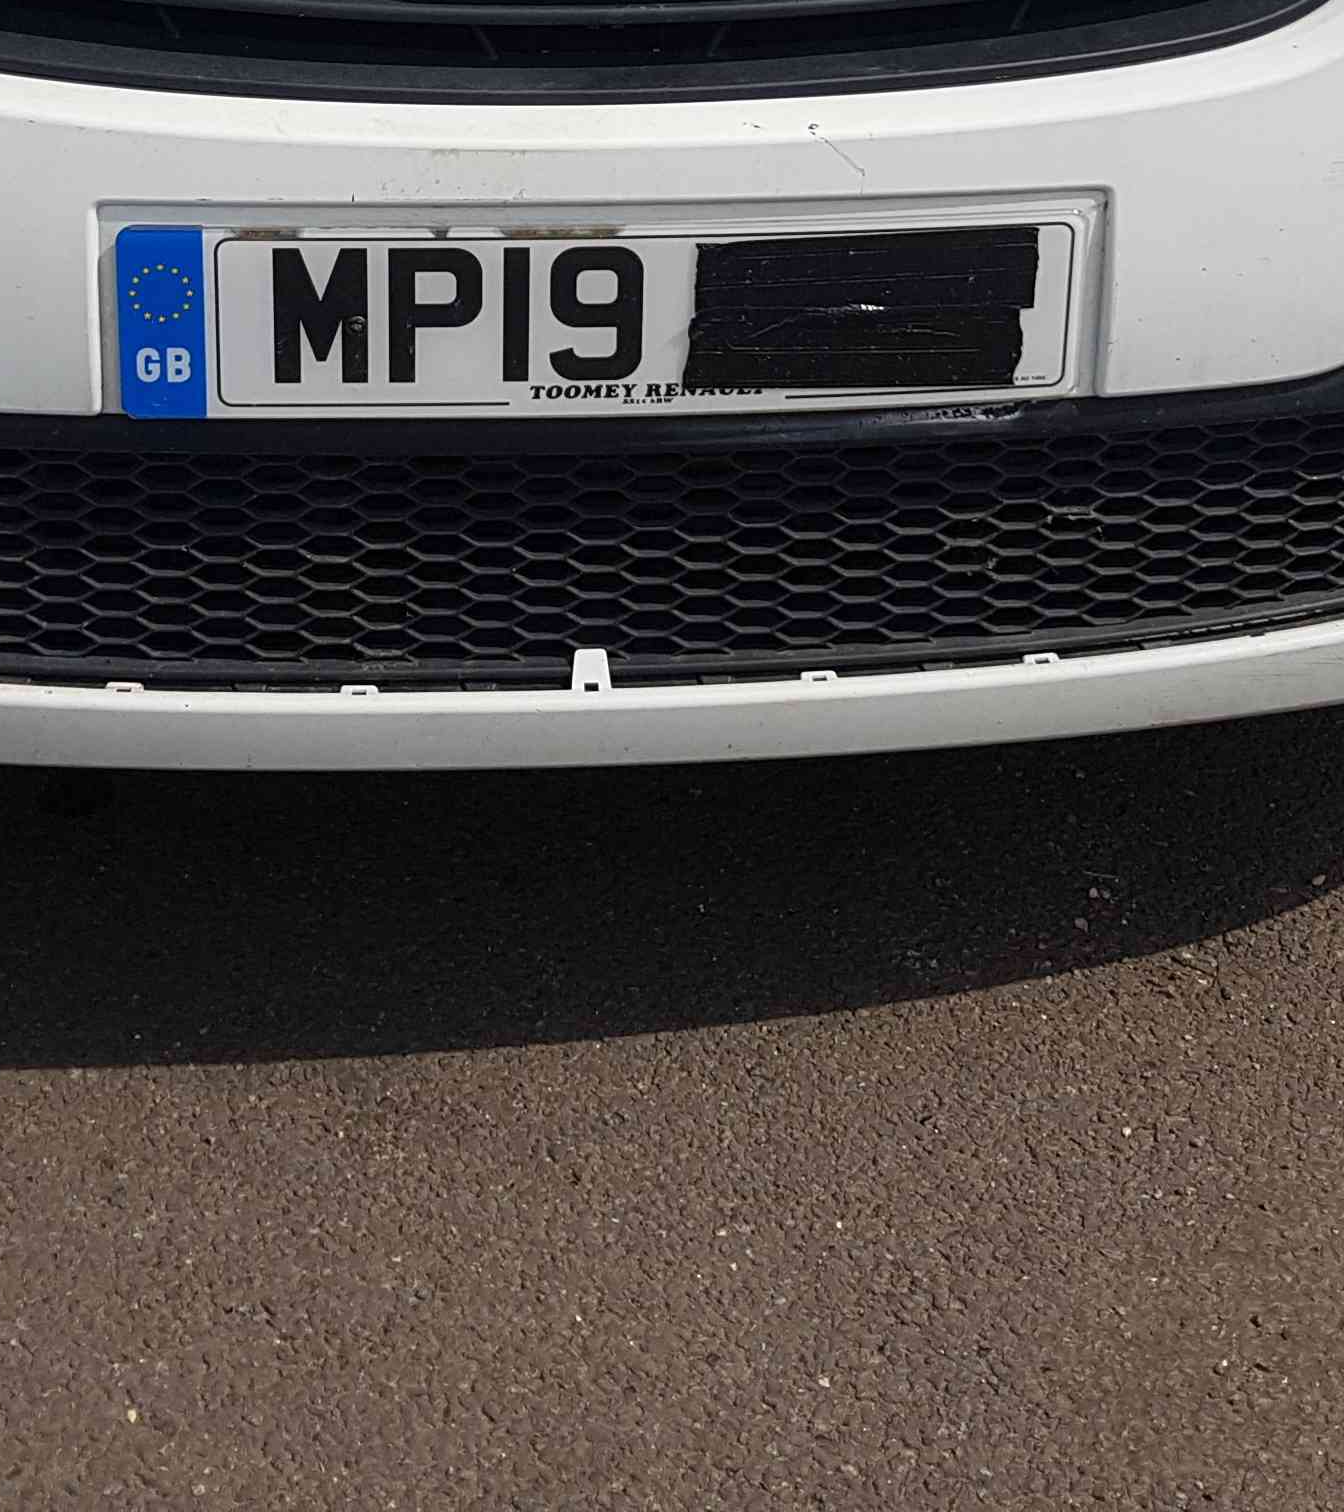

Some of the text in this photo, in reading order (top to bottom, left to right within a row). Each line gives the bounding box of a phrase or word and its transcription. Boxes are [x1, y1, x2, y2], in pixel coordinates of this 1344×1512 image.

[271, 245, 645, 384] MP19
[135, 346, 192, 384] GB
[529, 383, 638, 400] TOOMEY
